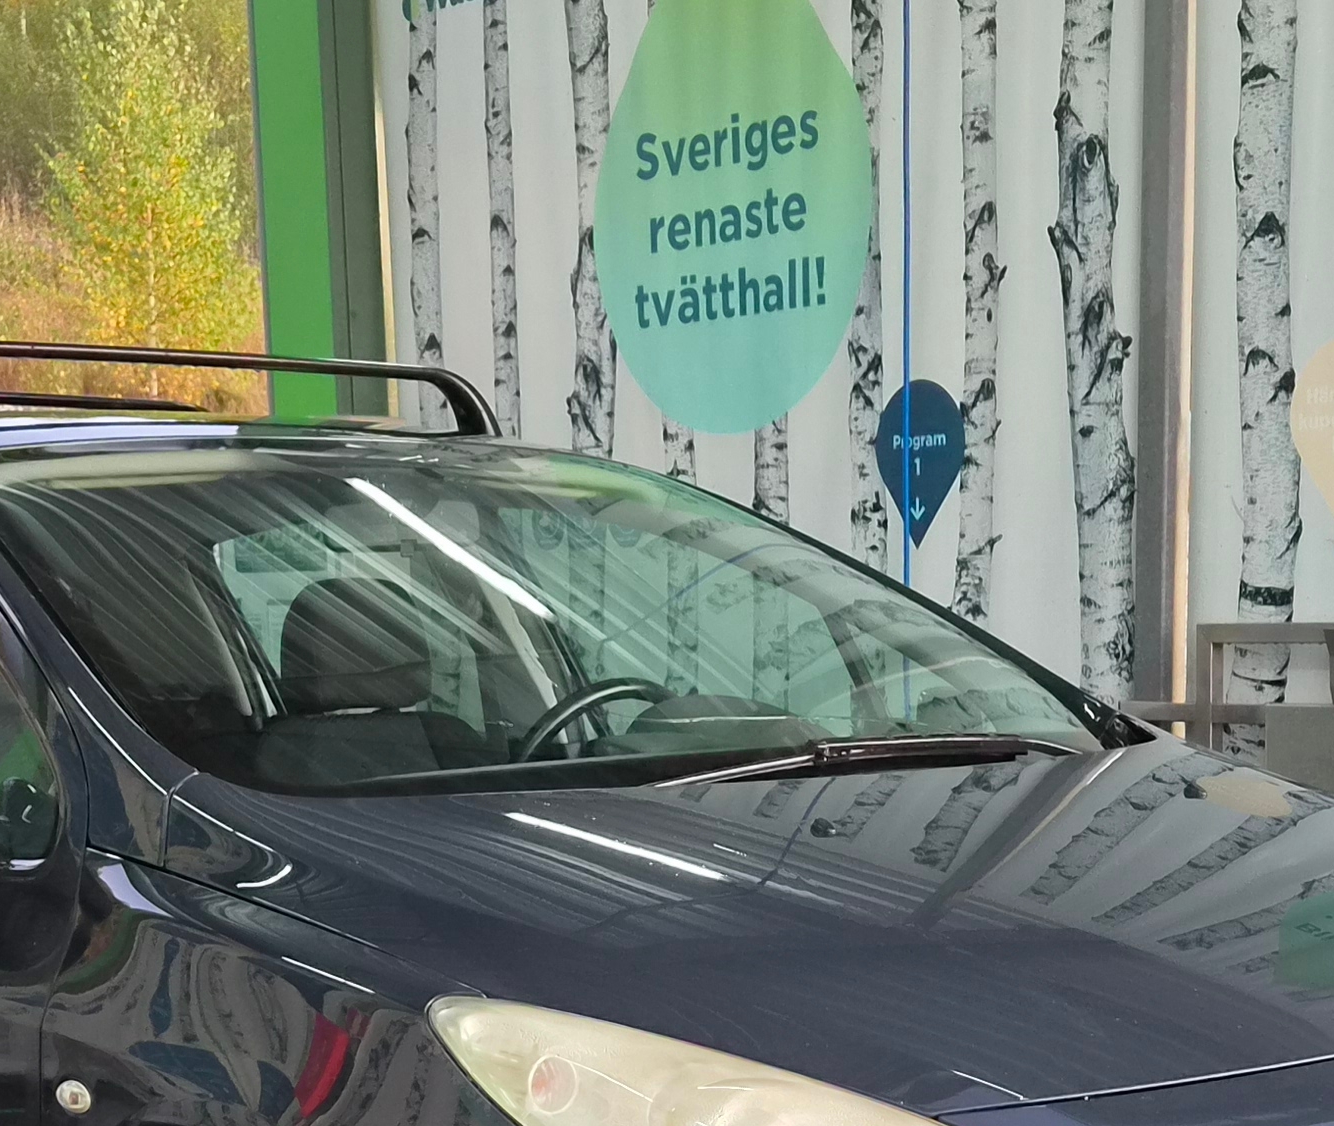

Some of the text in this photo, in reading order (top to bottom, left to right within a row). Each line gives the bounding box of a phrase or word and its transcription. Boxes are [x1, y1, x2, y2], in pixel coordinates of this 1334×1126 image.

[635, 109, 820, 181] Sveriges
[649, 187, 808, 254] renaste
[634, 255, 827, 330] tvätthall!
[913, 456, 921, 476] 1
